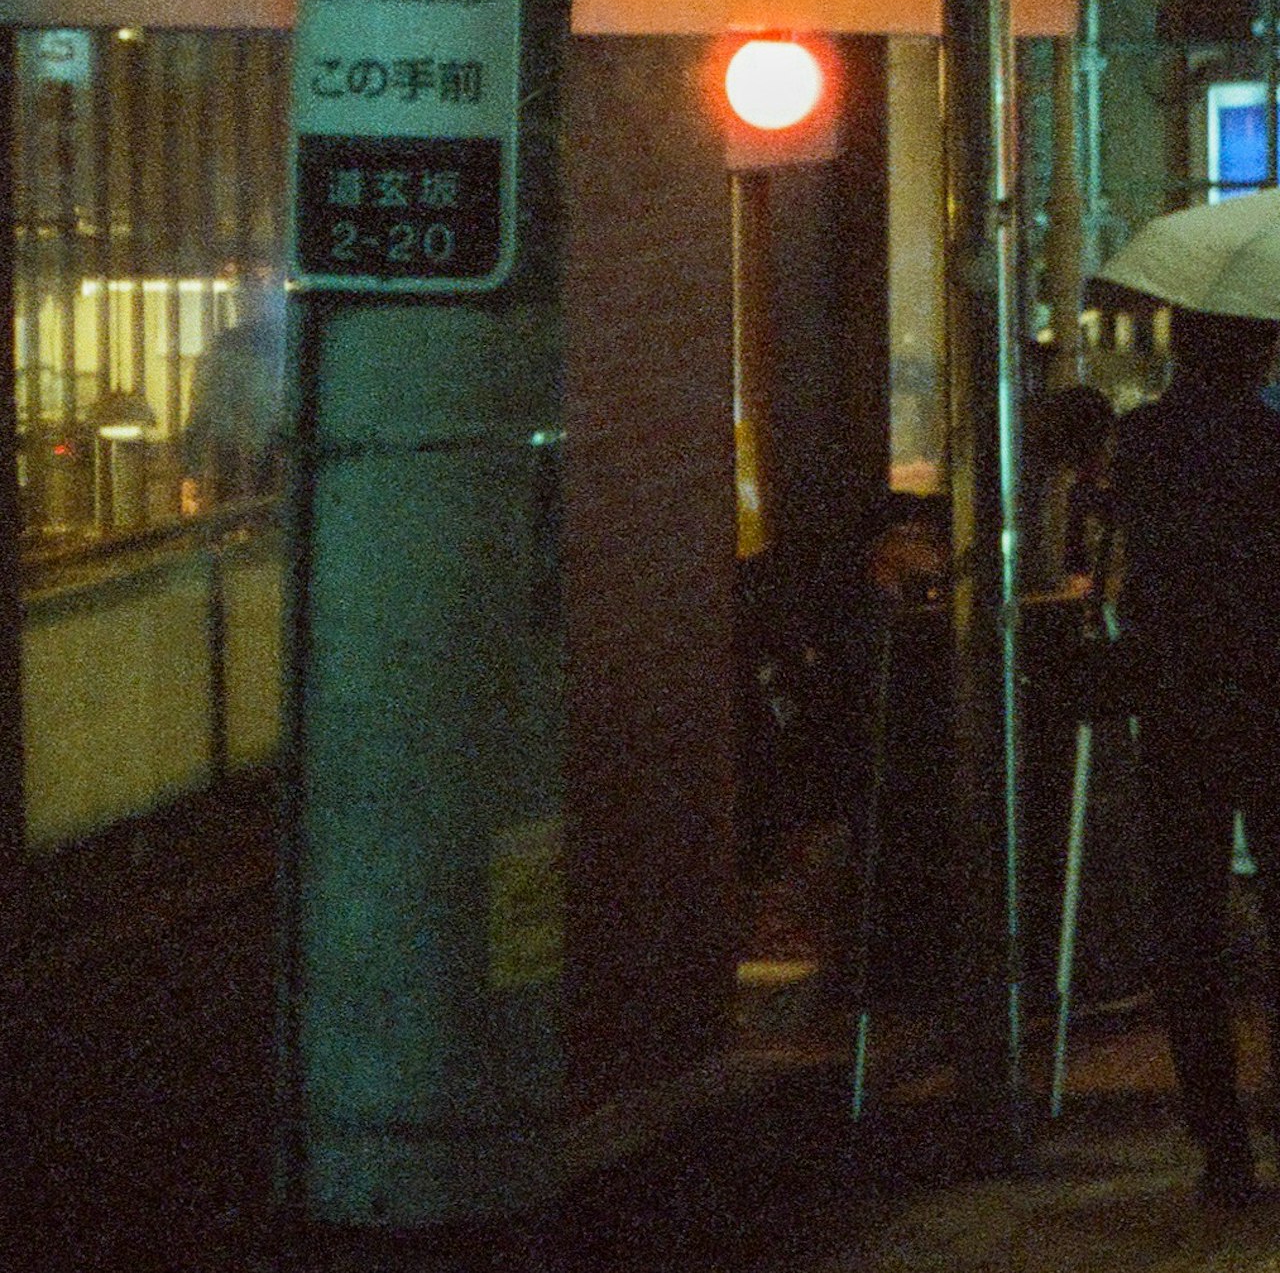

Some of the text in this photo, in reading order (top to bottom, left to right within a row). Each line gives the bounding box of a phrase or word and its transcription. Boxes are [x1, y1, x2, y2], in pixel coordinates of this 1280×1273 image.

[311, 59, 483, 103] この手前
[331, 220, 455, 263] 2-20
